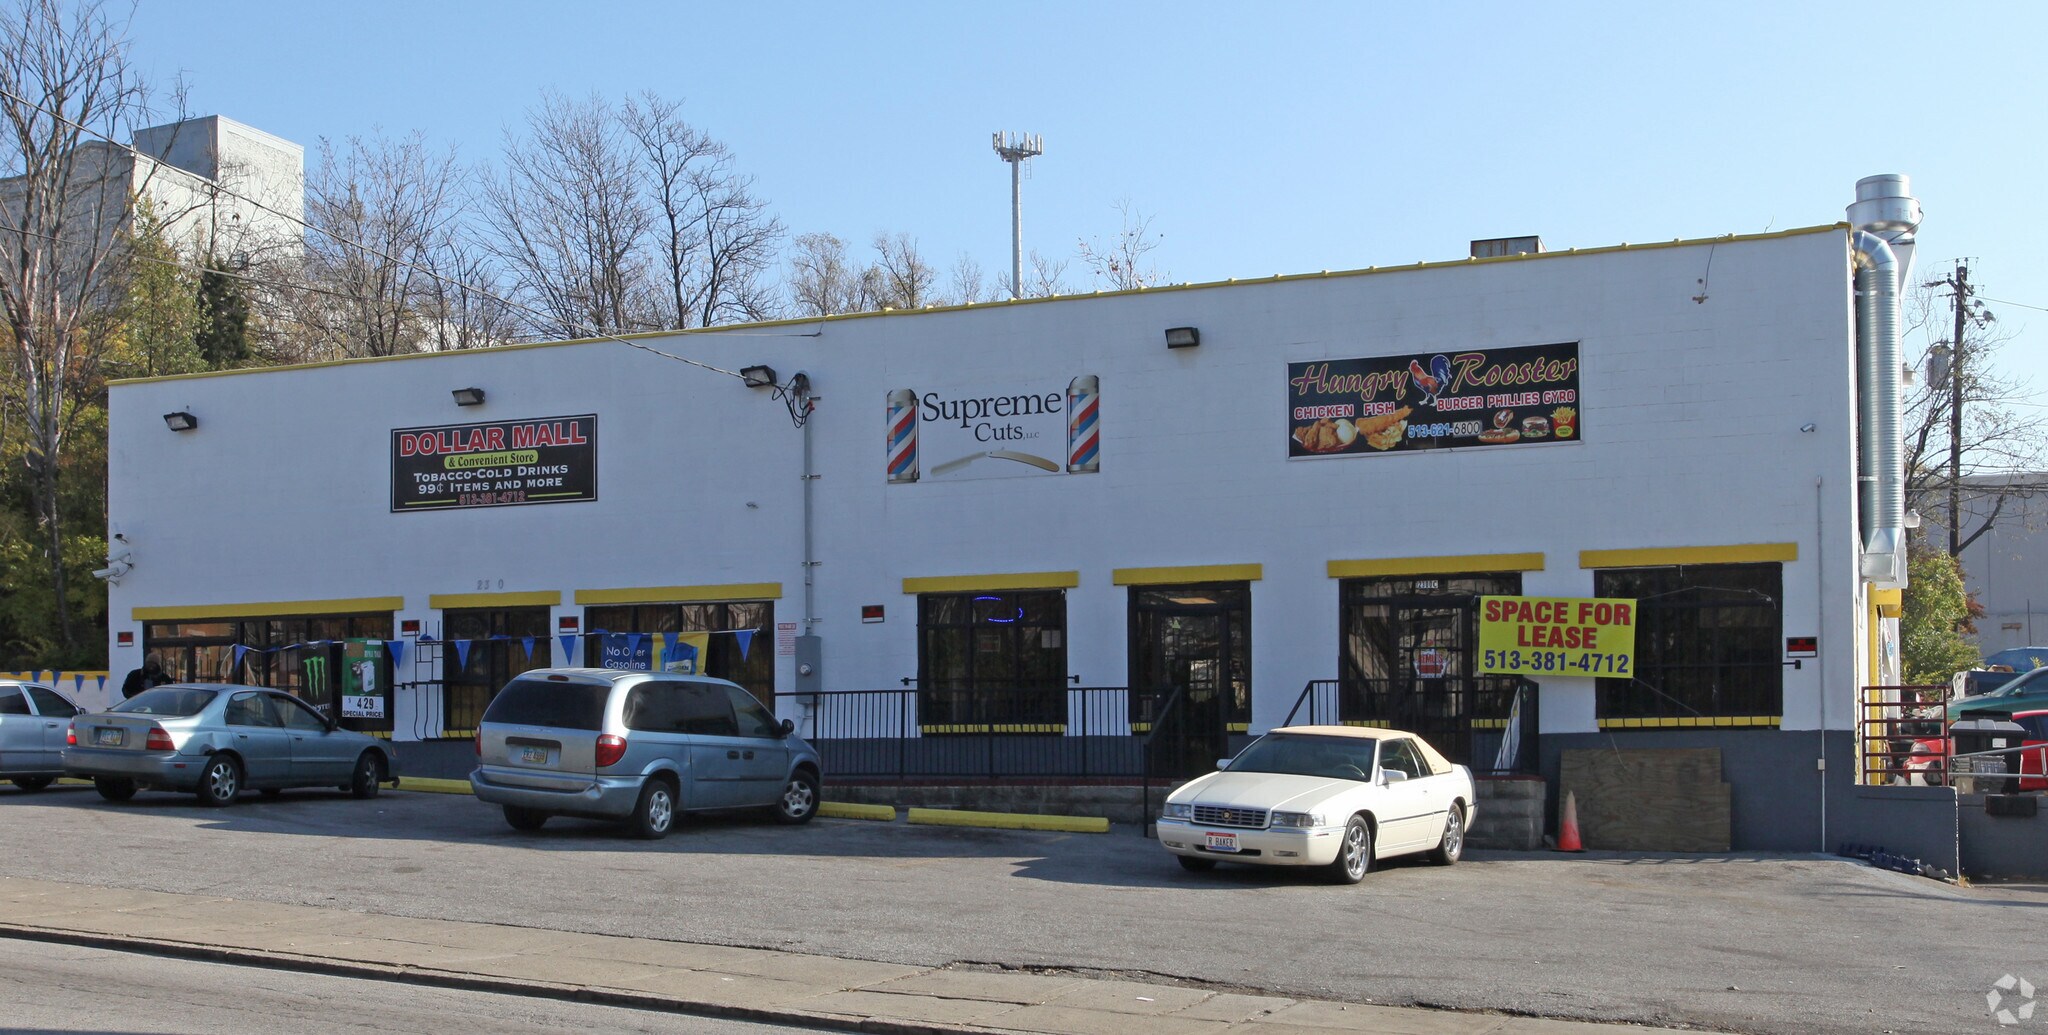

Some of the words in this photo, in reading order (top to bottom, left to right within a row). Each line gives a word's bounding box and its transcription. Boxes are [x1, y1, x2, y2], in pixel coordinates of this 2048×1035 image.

[1291, 363, 1409, 402] Hungry
[1451, 352, 1577, 393] Rooster
[1437, 395, 1483, 412] BURGER
[1487, 393, 1540, 408] PHILLIES
[1542, 389, 1576, 404] GYRO
[922, 392, 1062, 429] Supreme
[1293, 404, 1355, 420] CHICKEN
[1363, 401, 1396, 416] FISH
[400, 427, 505, 457] DOLLAR
[512, 421, 587, 449] MALL
[1408, 421, 1481, 438] 513-621-6800
[448, 456, 456, 467] &
[458, 454, 509, 467] Convenient
[510, 453, 534, 464] Store
[517, 465, 569, 477] DRINKS
[450, 481, 490, 493] ITEMS
[495, 480, 522, 490] AND
[526, 477, 563, 488] MORE
[1485, 600, 1569, 624] SPACE
[1578, 602, 1631, 626] FOR
[1518, 625, 1597, 649] LEASE
[606, 646, 620, 657] No
[622, 646, 645, 657] Oer
[605, 659, 646, 670] Gasoline
[1484, 650, 1629, 674] 513-381-4712
[1208, 837, 1213, 845] R
[1216, 838, 1234, 847] BAKER
